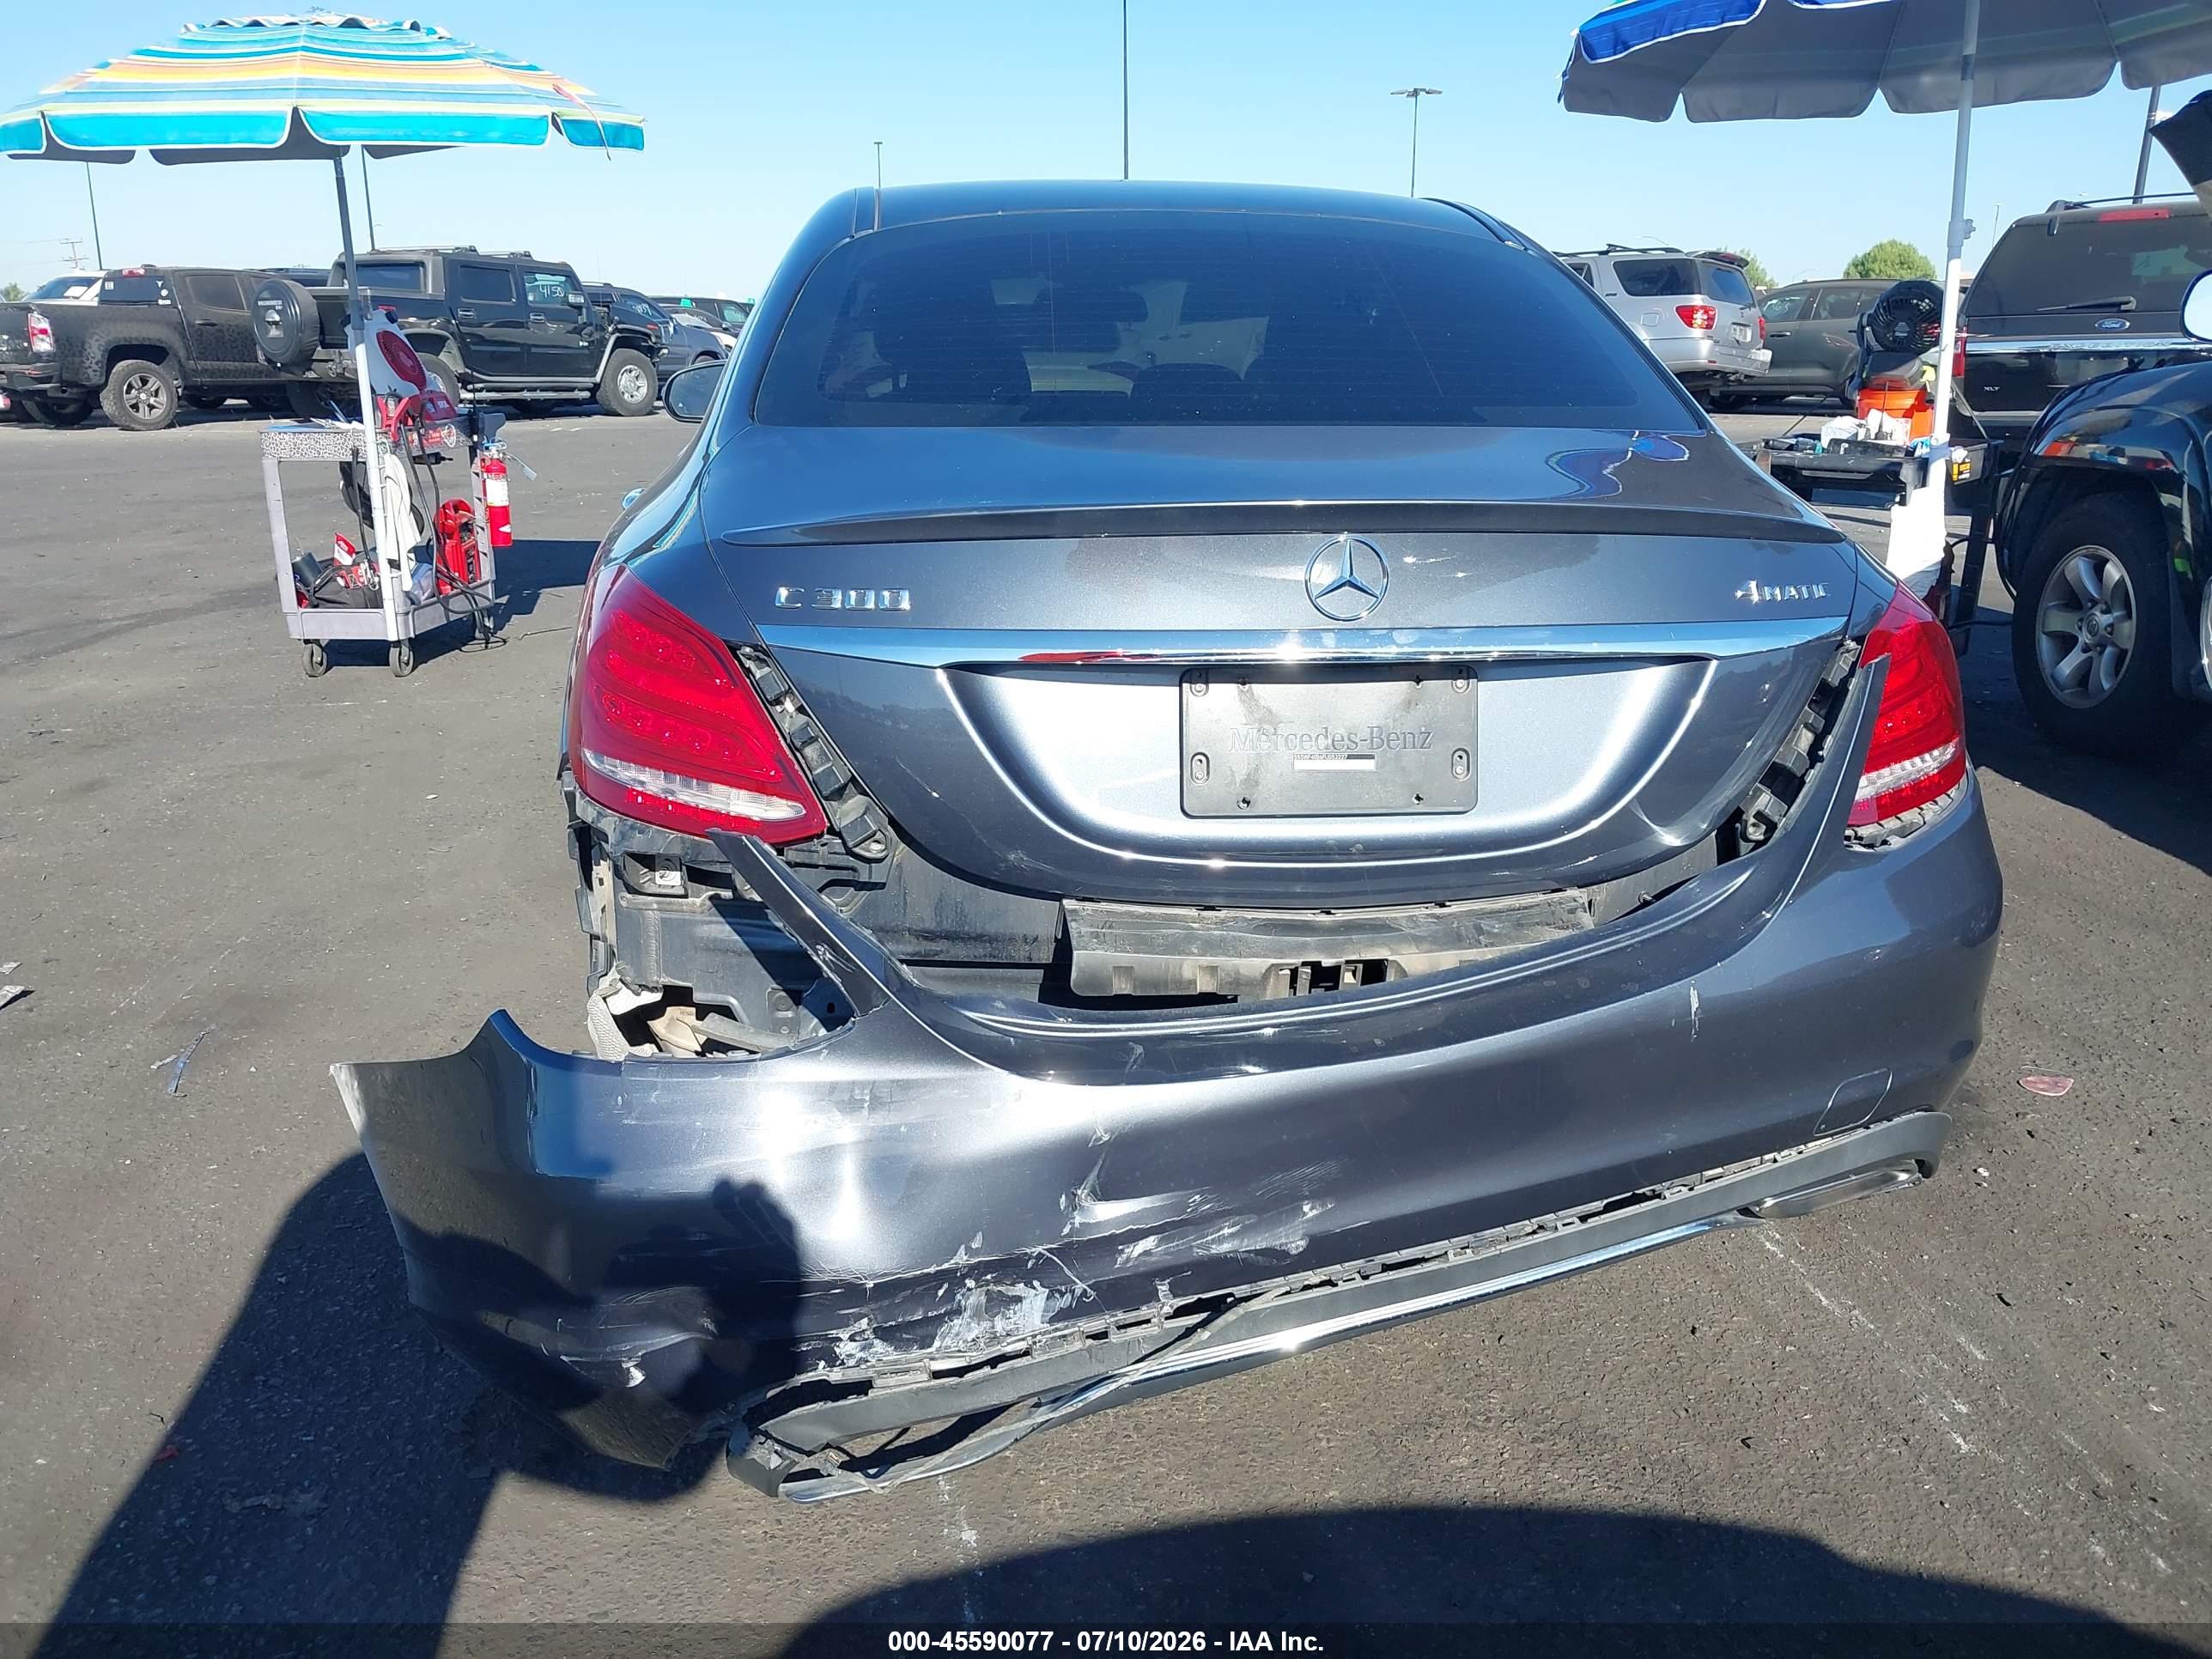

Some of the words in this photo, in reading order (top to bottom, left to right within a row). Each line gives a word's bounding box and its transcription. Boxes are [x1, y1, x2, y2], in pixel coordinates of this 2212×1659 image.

[774, 585, 805, 610] C
[811, 586, 912, 612] 300
[1735, 579, 1832, 605] 4MATIC
[1229, 726, 1434, 752] Mercedes-Benz
